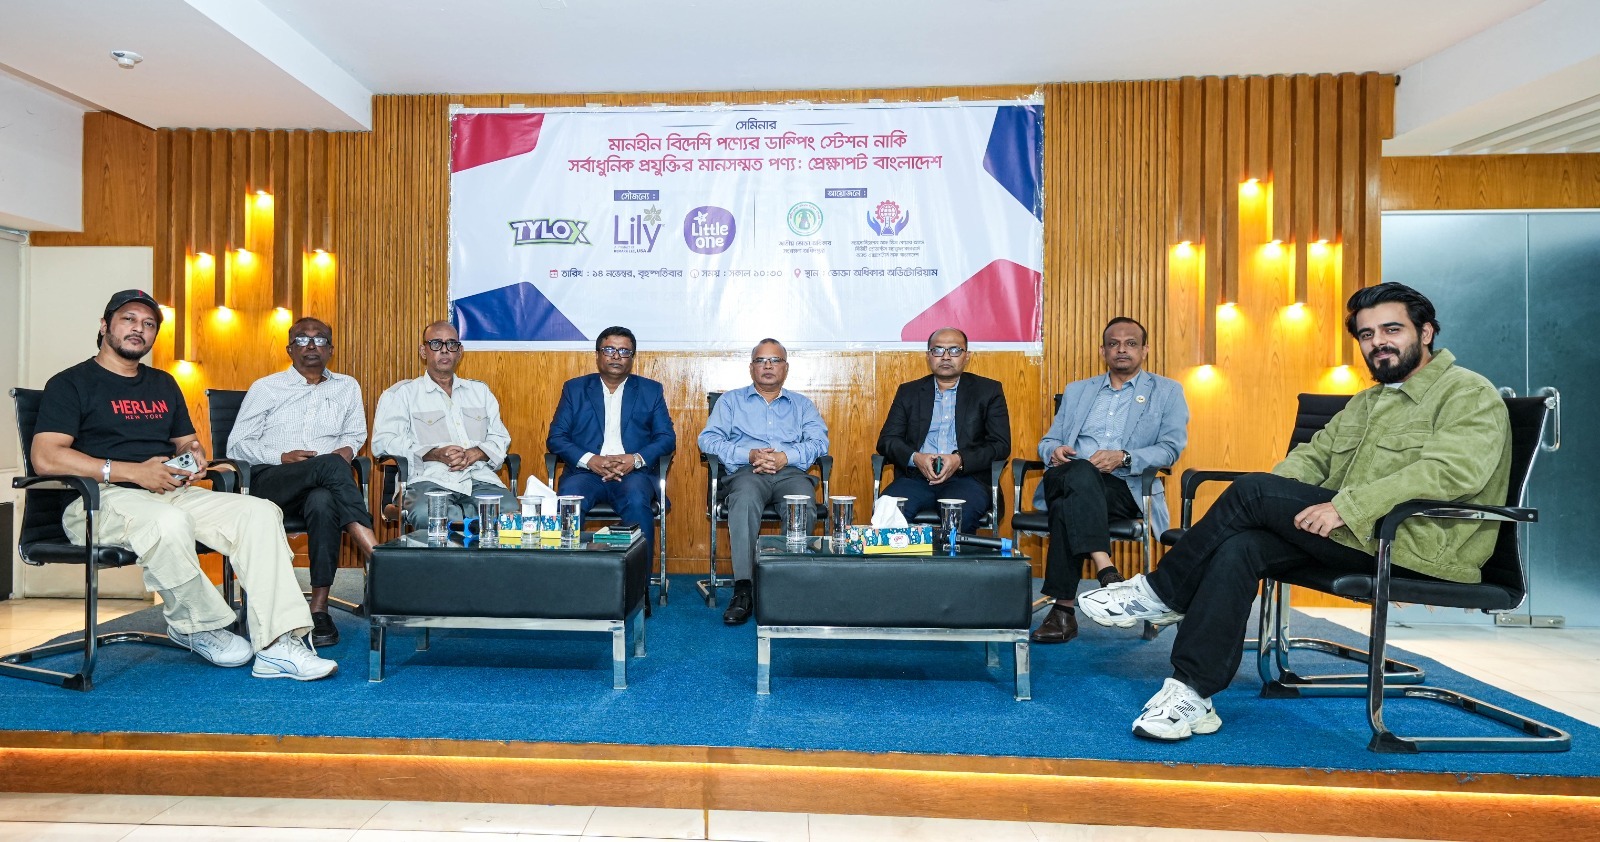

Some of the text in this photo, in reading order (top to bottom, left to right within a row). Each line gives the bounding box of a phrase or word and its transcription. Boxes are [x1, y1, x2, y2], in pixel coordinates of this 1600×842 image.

[735, 117, 777, 131] সেমিনার
[608, 129, 907, 152] মানহীন বিদেশি পণ্যের ডাম্পিং স্টেশন নাকি
[568, 154, 635, 177] সর্বাধুনিক
[638, 153, 693, 177] প্রযুক্তির
[698, 157, 764, 173] মানসম্মত
[808, 153, 868, 171] প্রেক্ষাপট
[872, 155, 942, 172] বাংলাদেশ
[509, 219, 591, 245] TYLOX
[614, 214, 662, 252] Lily
[691, 222, 729, 236] Little
[561, 267, 583, 278] তারিখ
[592, 270, 604, 278] ১৪
[638, 267, 683, 280] বৃহস্পতিবার
[701, 269, 720, 278] সময়
[728, 269, 751, 278] সকাল
[804, 268, 819, 279] স্থান
[853, 266, 884, 278] অধিকার
[887, 266, 938, 278] অডিটোরিয়াম
[111, 400, 168, 414] HERLAN
